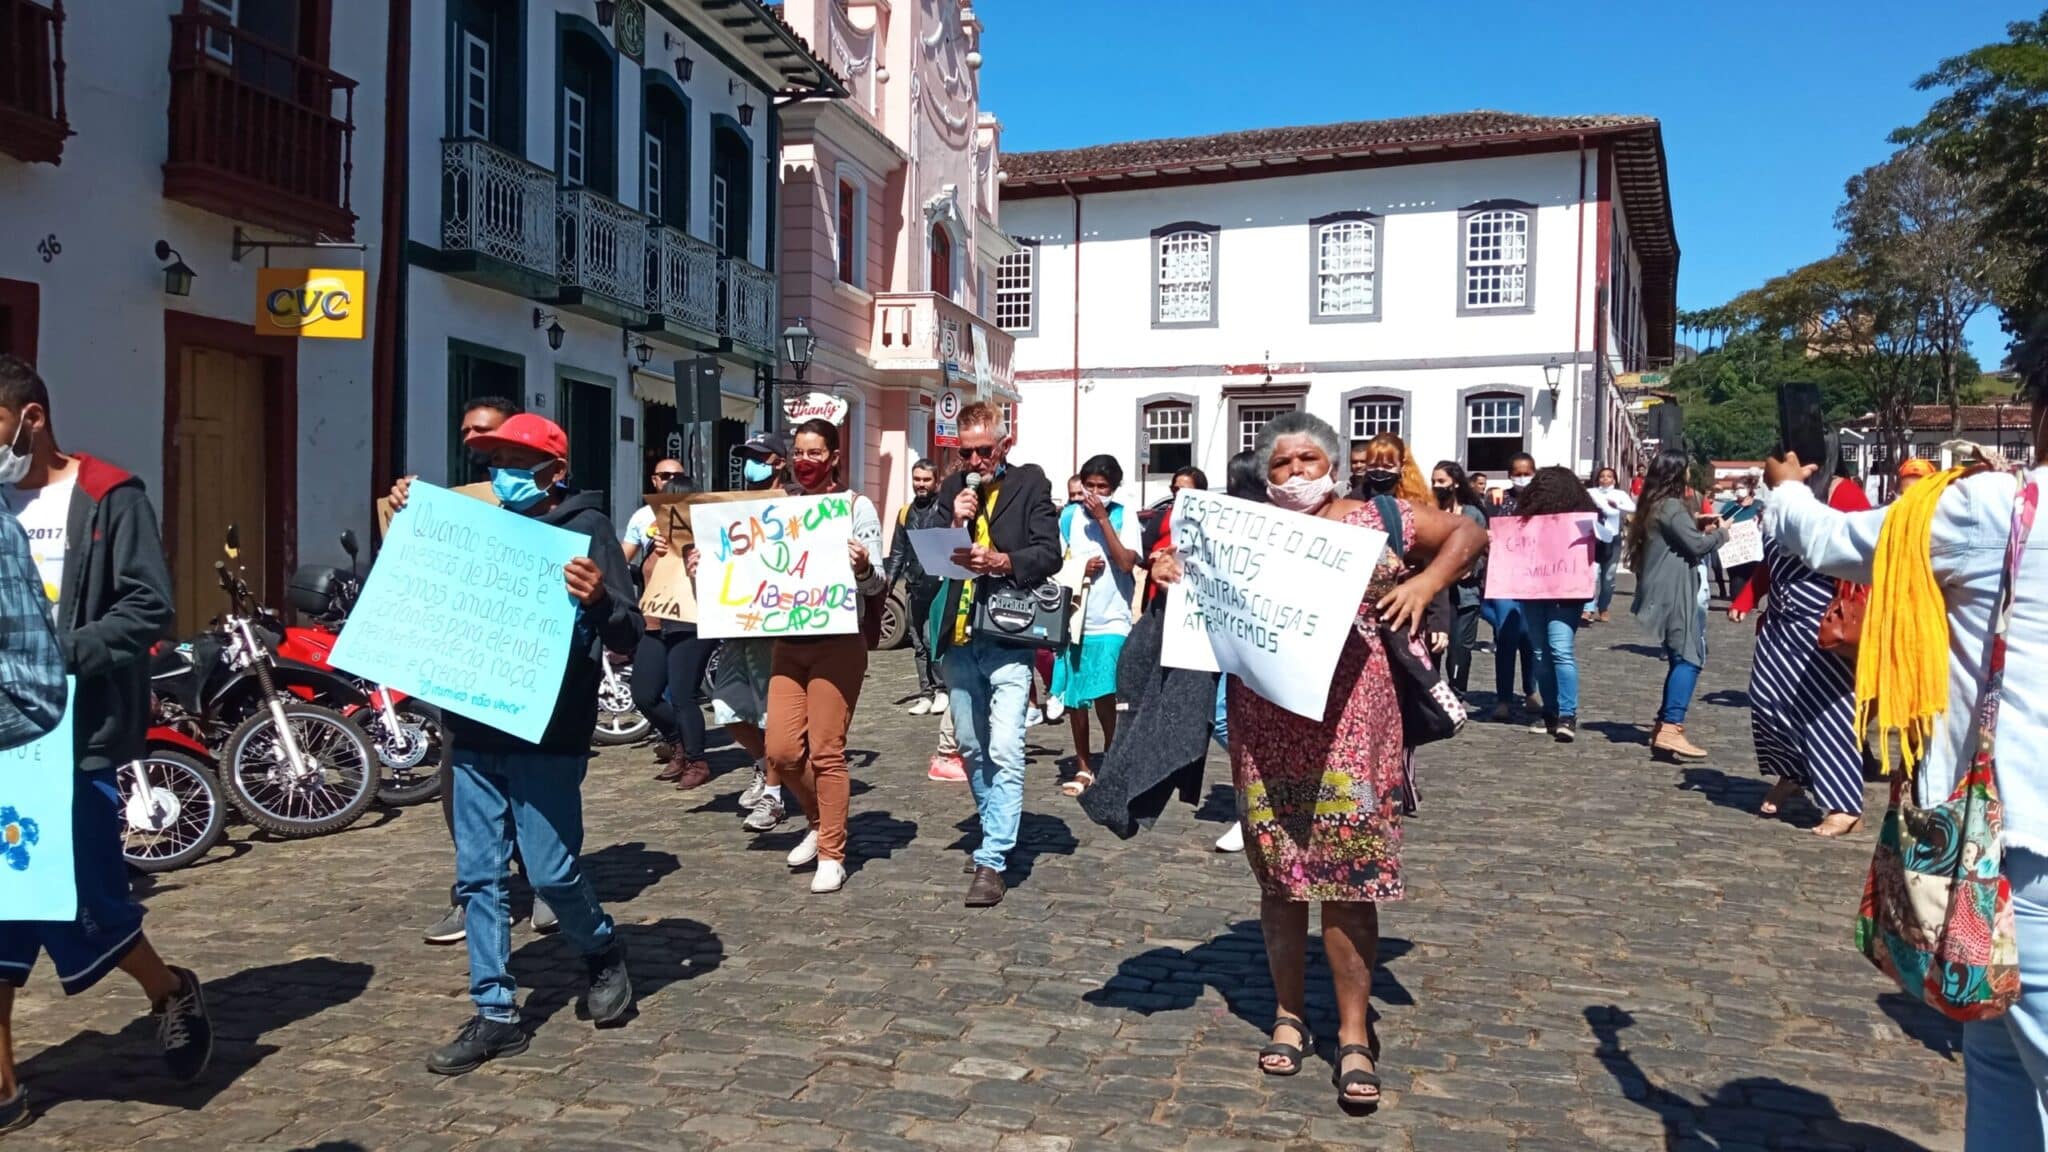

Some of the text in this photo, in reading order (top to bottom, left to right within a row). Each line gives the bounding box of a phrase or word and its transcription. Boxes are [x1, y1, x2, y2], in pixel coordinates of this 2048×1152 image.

[36, 233, 62, 263] 36
[266, 288, 351, 321] CVC
[788, 397, 838, 419] Chanty
[28, 528, 63, 540] 2017
[714, 504, 784, 562] ASAS
[1181, 495, 1267, 541] RESPEITO
[1284, 530, 1303, 554] O
[1304, 536, 1352, 572] QUE
[760, 541, 809, 579] DA
[1179, 528, 1265, 582] EXIGIMOS
[459, 564, 482, 587] de
[484, 560, 529, 599] Deus
[535, 583, 549, 605] e
[719, 562, 857, 611] LIBERDADE
[523, 611, 537, 632] e
[736, 608, 829, 633] #CAPS
[1250, 593, 1319, 637] COISAS
[471, 693, 491, 708] não
